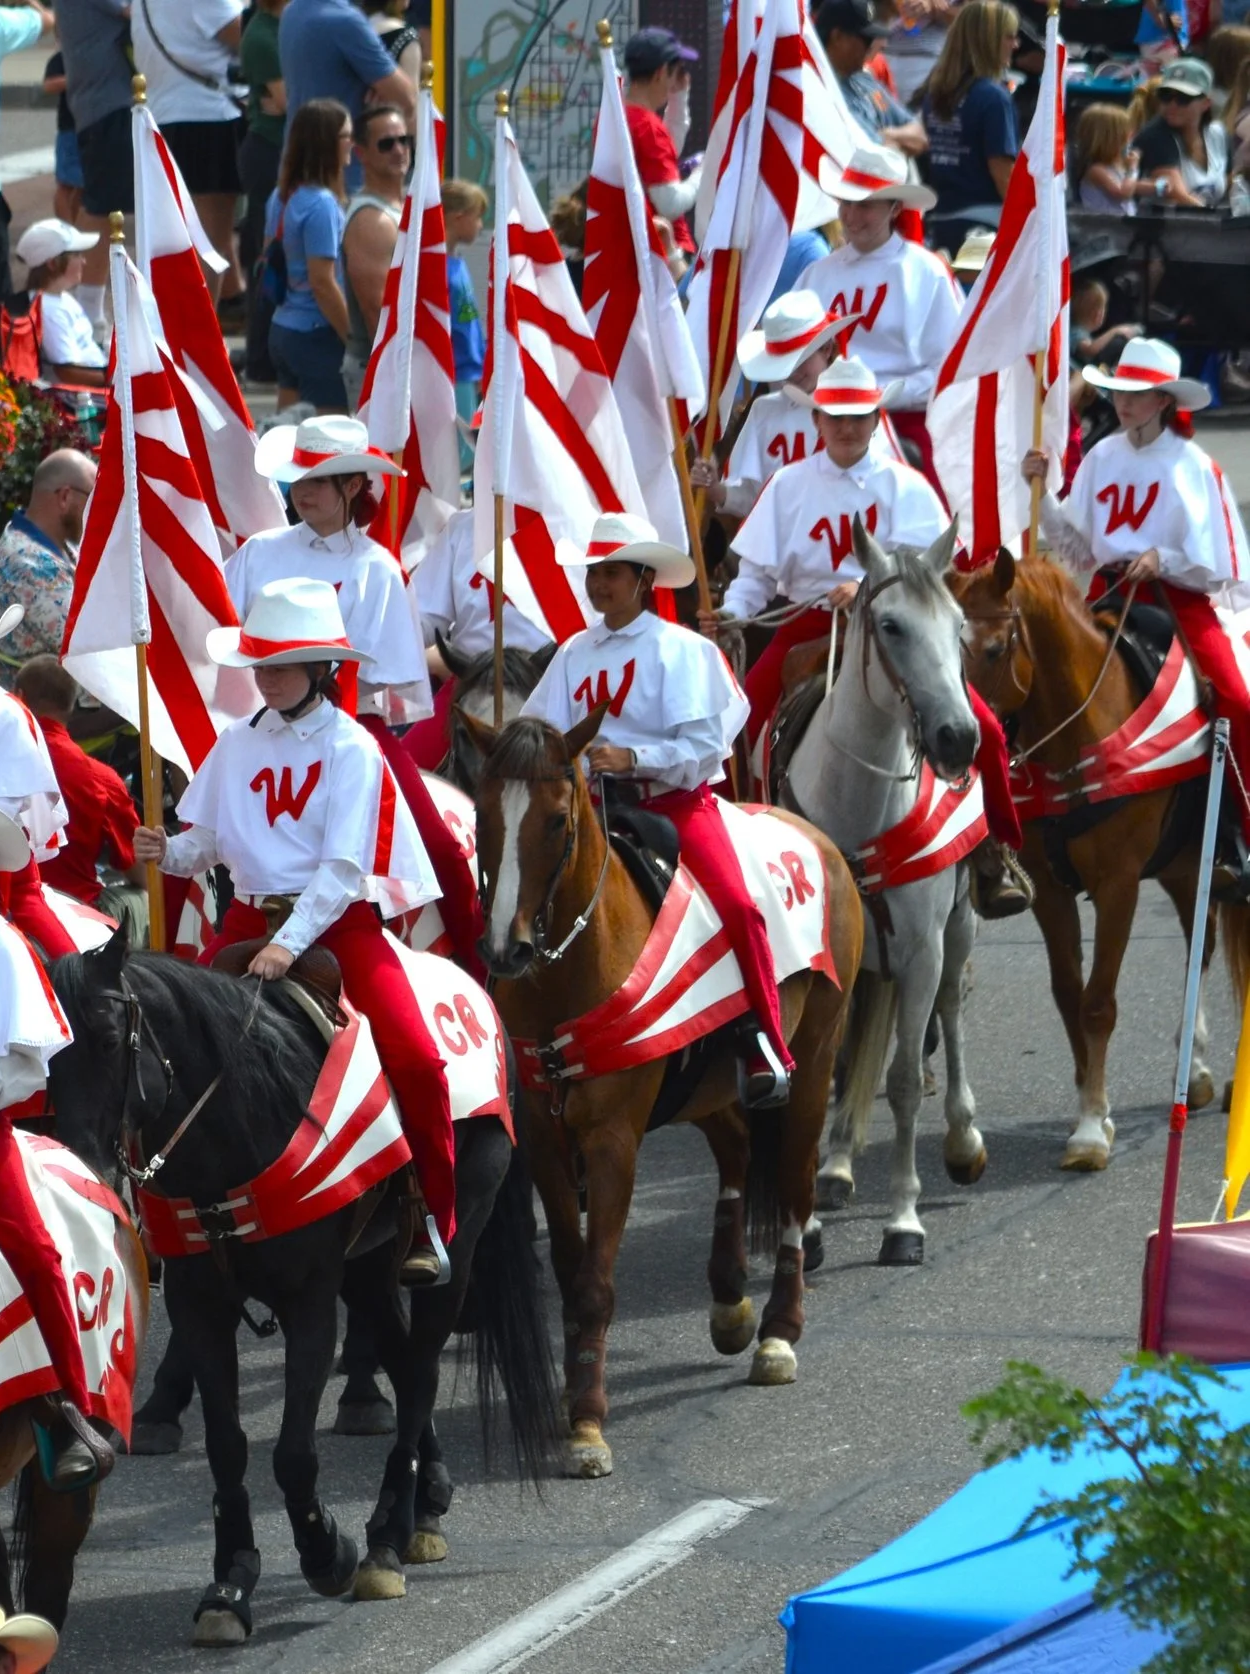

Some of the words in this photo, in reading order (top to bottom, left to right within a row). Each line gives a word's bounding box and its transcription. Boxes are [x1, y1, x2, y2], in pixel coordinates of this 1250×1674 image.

[828, 282, 888, 333] W
[808, 502, 879, 572] W
[1096, 481, 1161, 534] W
[572, 657, 637, 718] W
[249, 760, 323, 826] W
[765, 851, 817, 912] CR
[432, 993, 490, 1057] CR
[73, 1266, 115, 1331] CR
